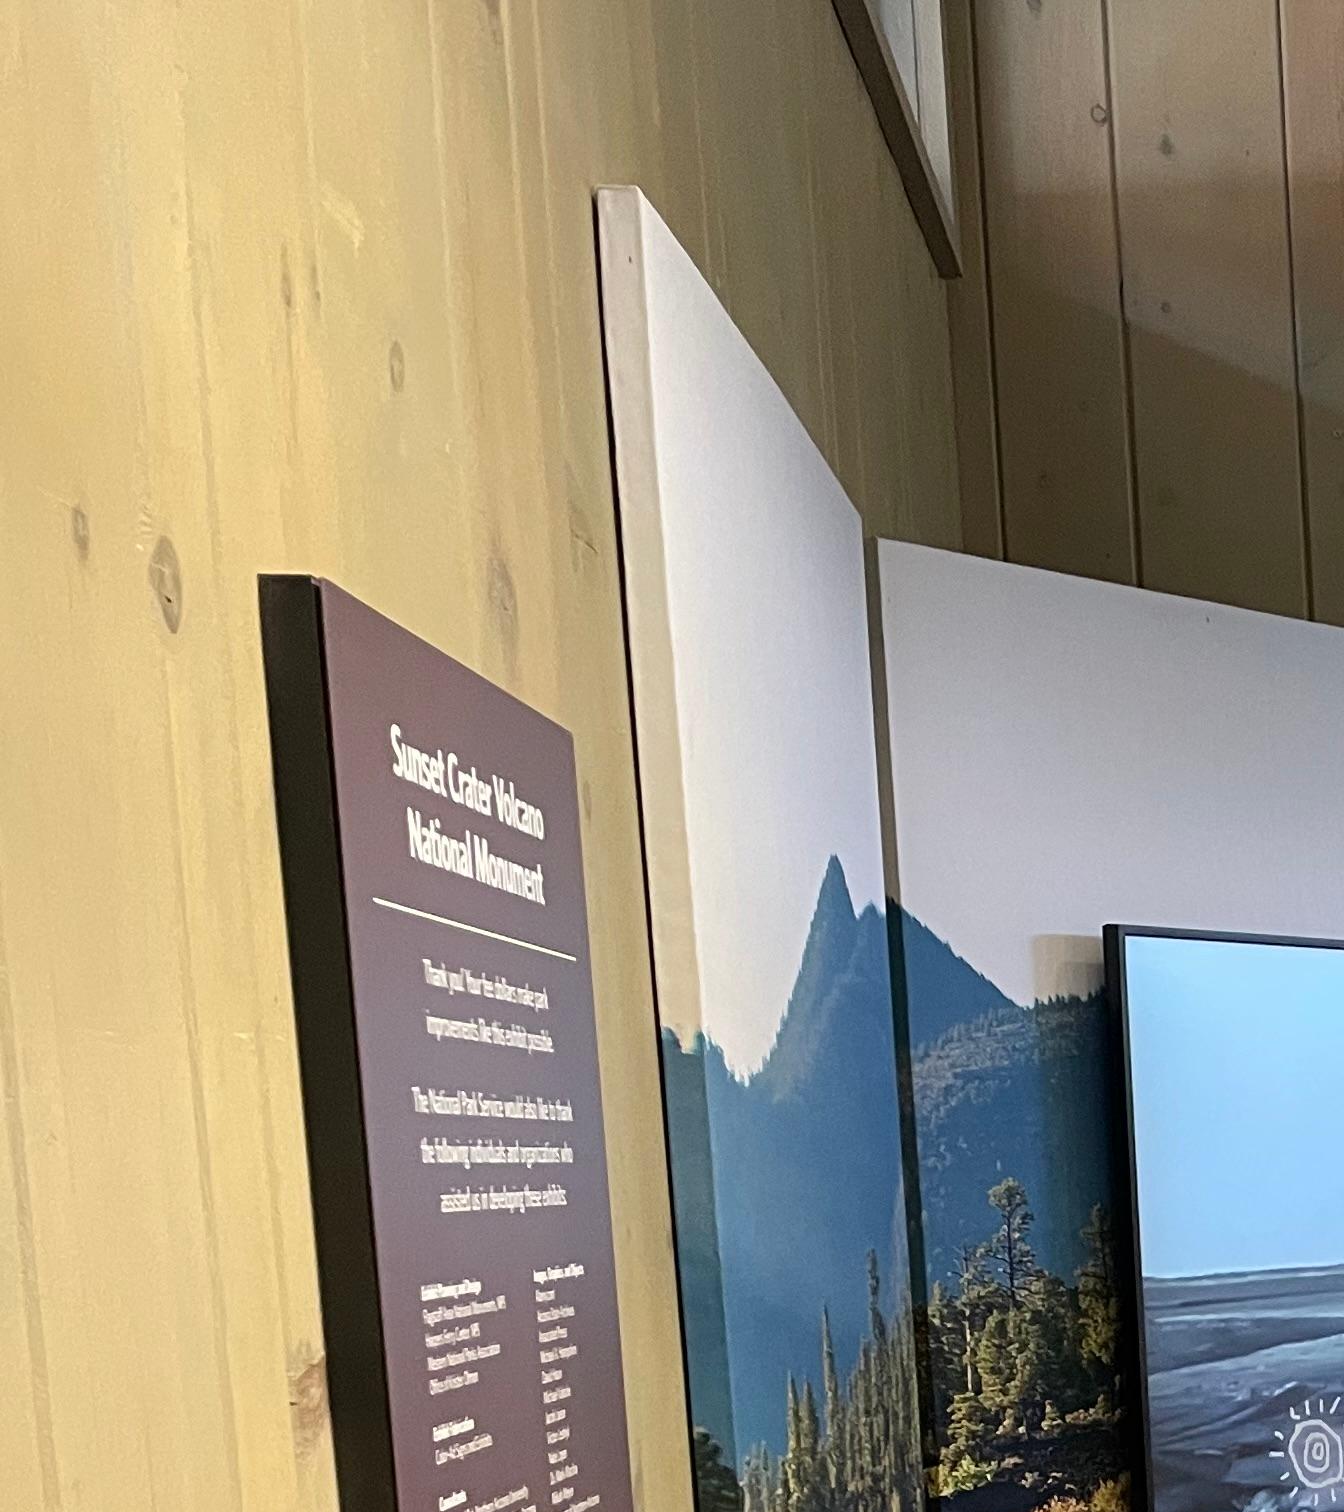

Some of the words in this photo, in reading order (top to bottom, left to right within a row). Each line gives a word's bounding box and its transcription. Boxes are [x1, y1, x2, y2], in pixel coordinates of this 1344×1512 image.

[390, 724, 447, 798] Sunset
[447, 752, 492, 816] Crater
[492, 774, 544, 840] Volcano
[407, 806, 474, 879] National
[474, 834, 545, 906] Monument
